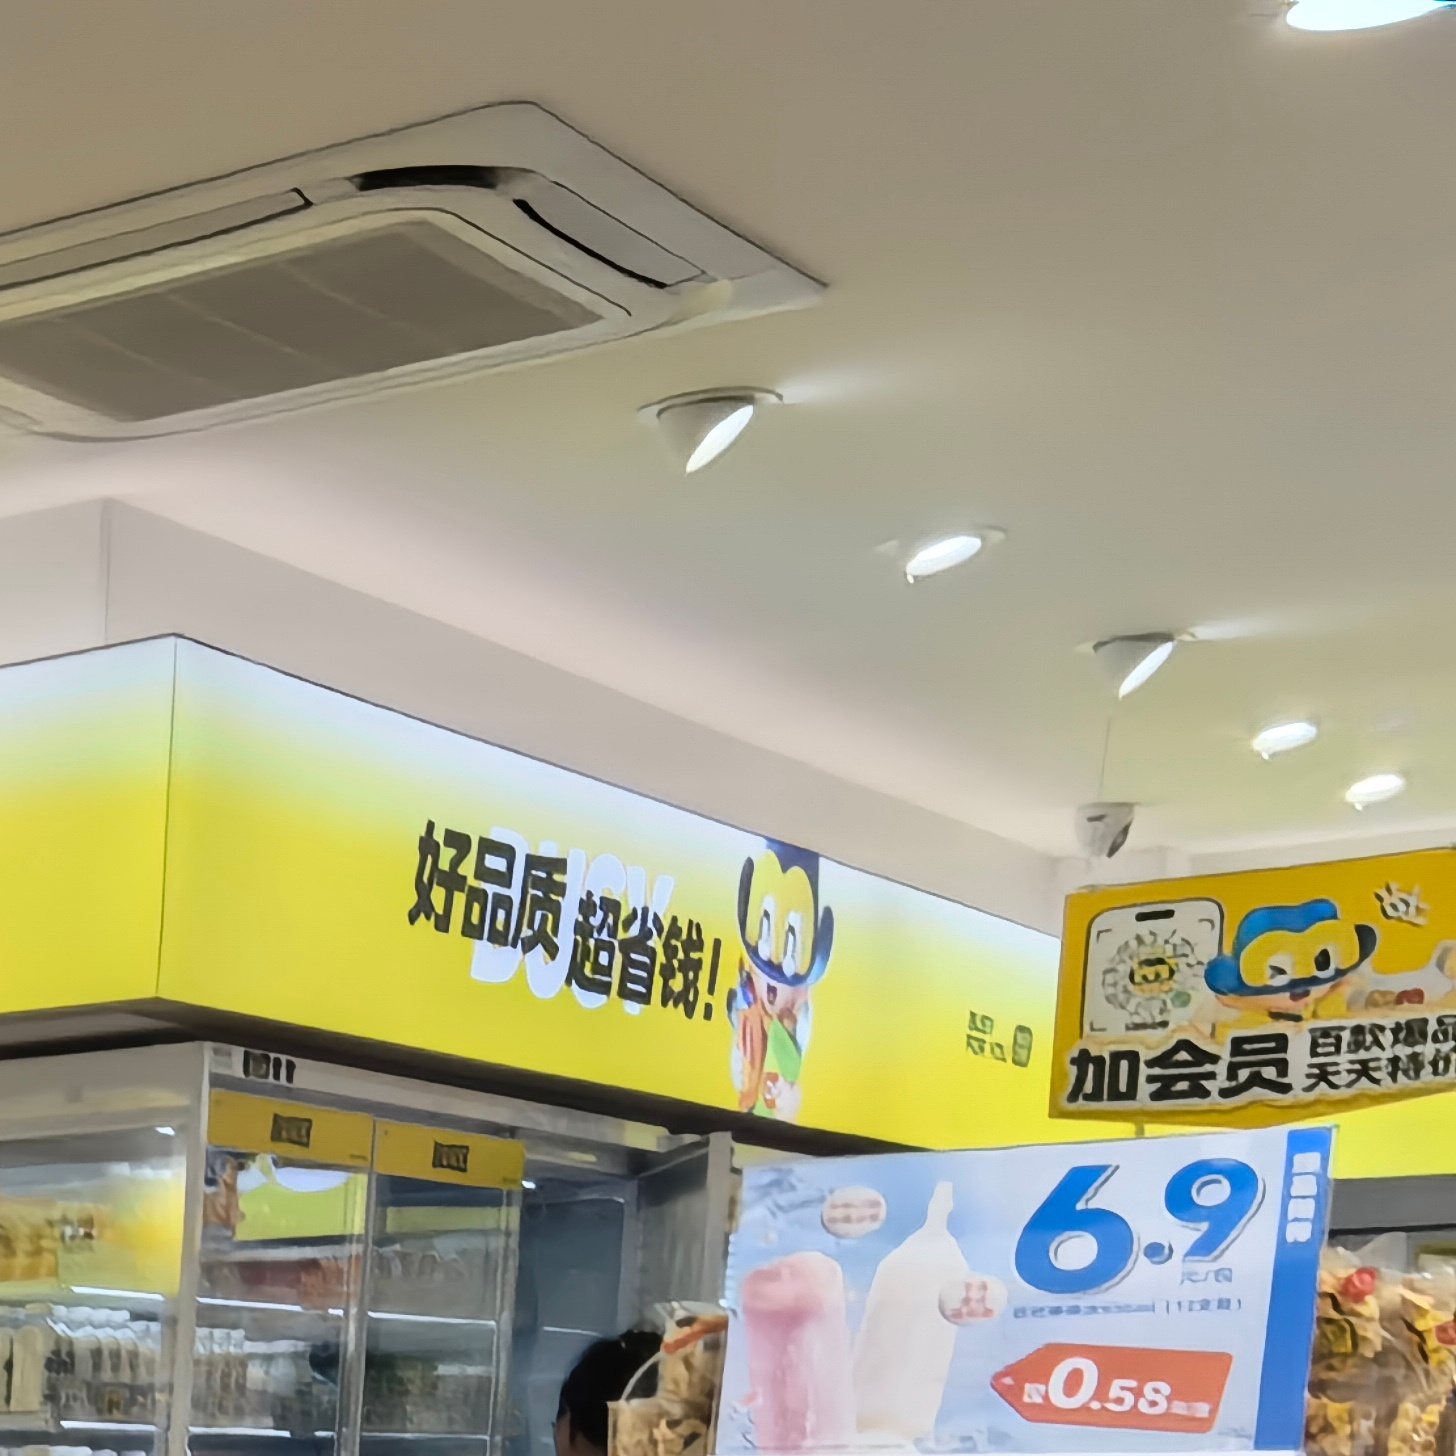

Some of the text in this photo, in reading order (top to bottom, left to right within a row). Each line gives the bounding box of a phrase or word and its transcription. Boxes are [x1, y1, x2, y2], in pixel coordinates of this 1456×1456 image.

[408, 819, 567, 960] 好品质
[1066, 1032, 1293, 1103] 加会员
[1015, 1158, 1266, 1294] 6.9
[1048, 1357, 1172, 1414] 0.58
